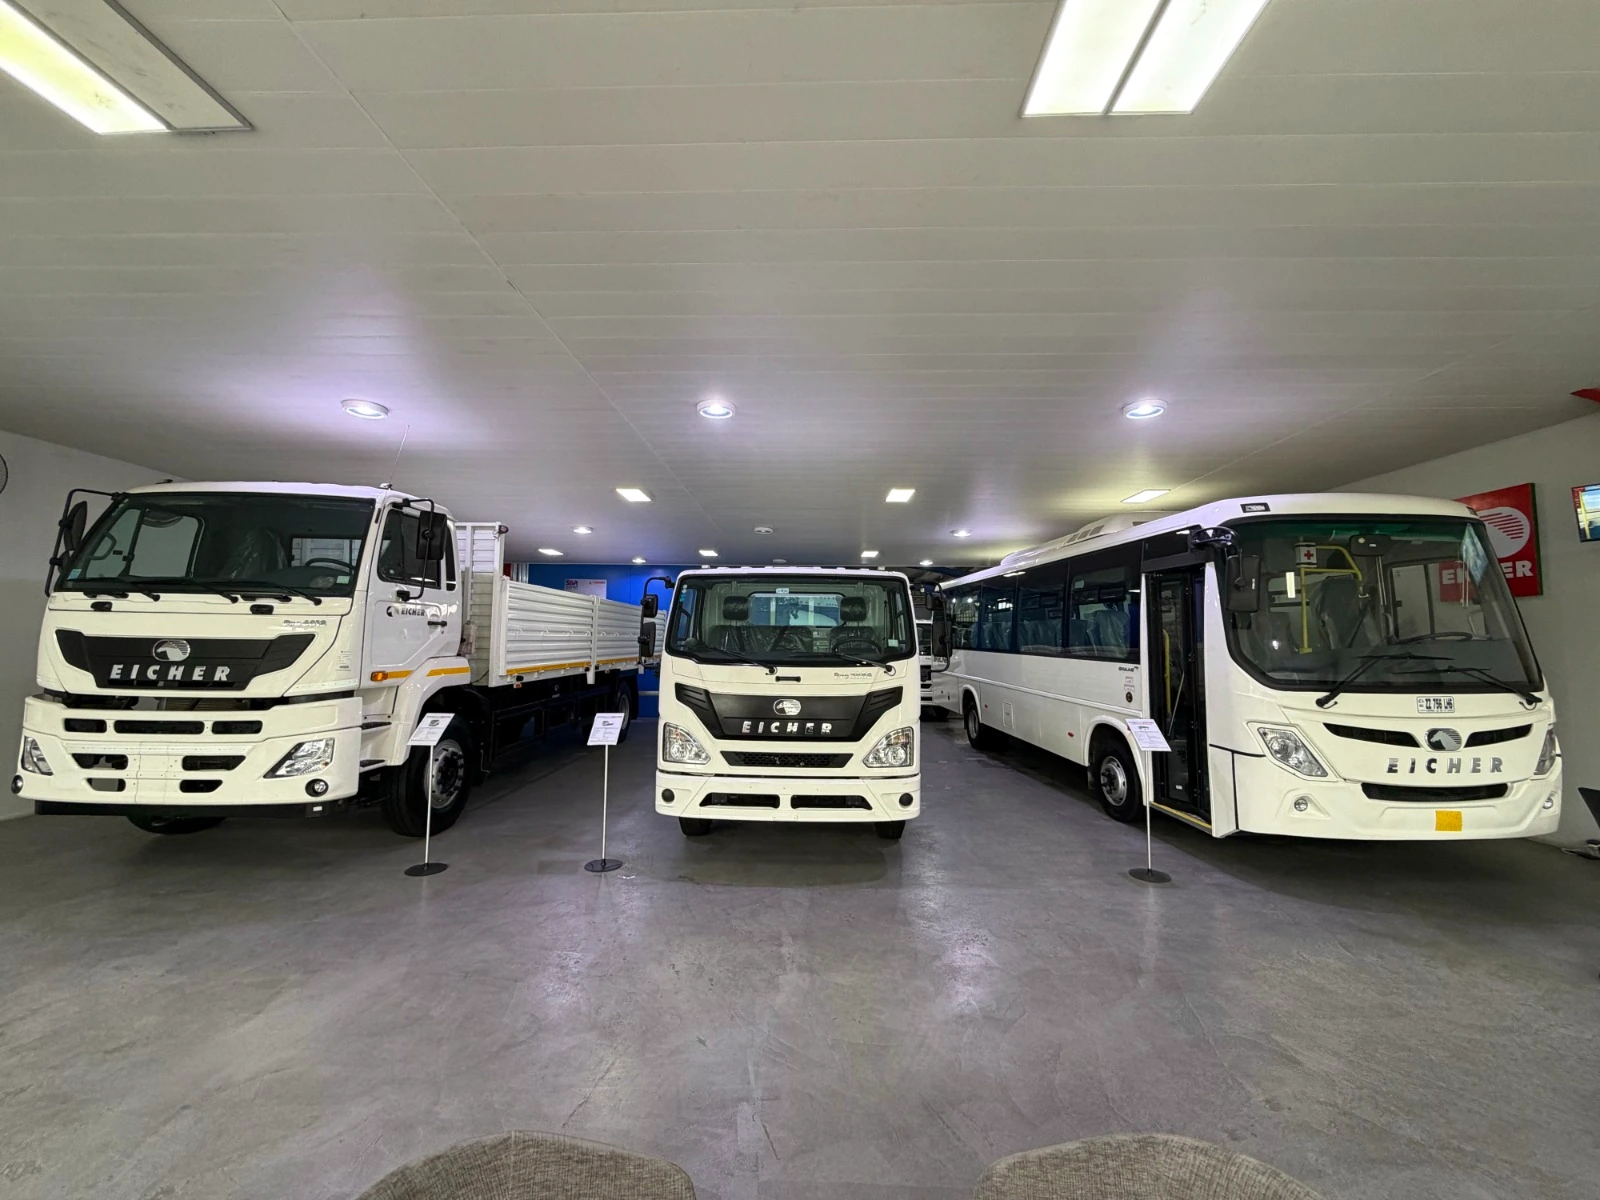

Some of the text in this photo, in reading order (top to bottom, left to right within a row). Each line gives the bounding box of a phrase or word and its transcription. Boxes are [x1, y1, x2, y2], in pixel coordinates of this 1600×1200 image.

[401, 607, 426, 617] EICHER
[109, 664, 231, 682] EICHER
[741, 720, 833, 735] EICHER
[1386, 757, 1503, 774] EICHER
